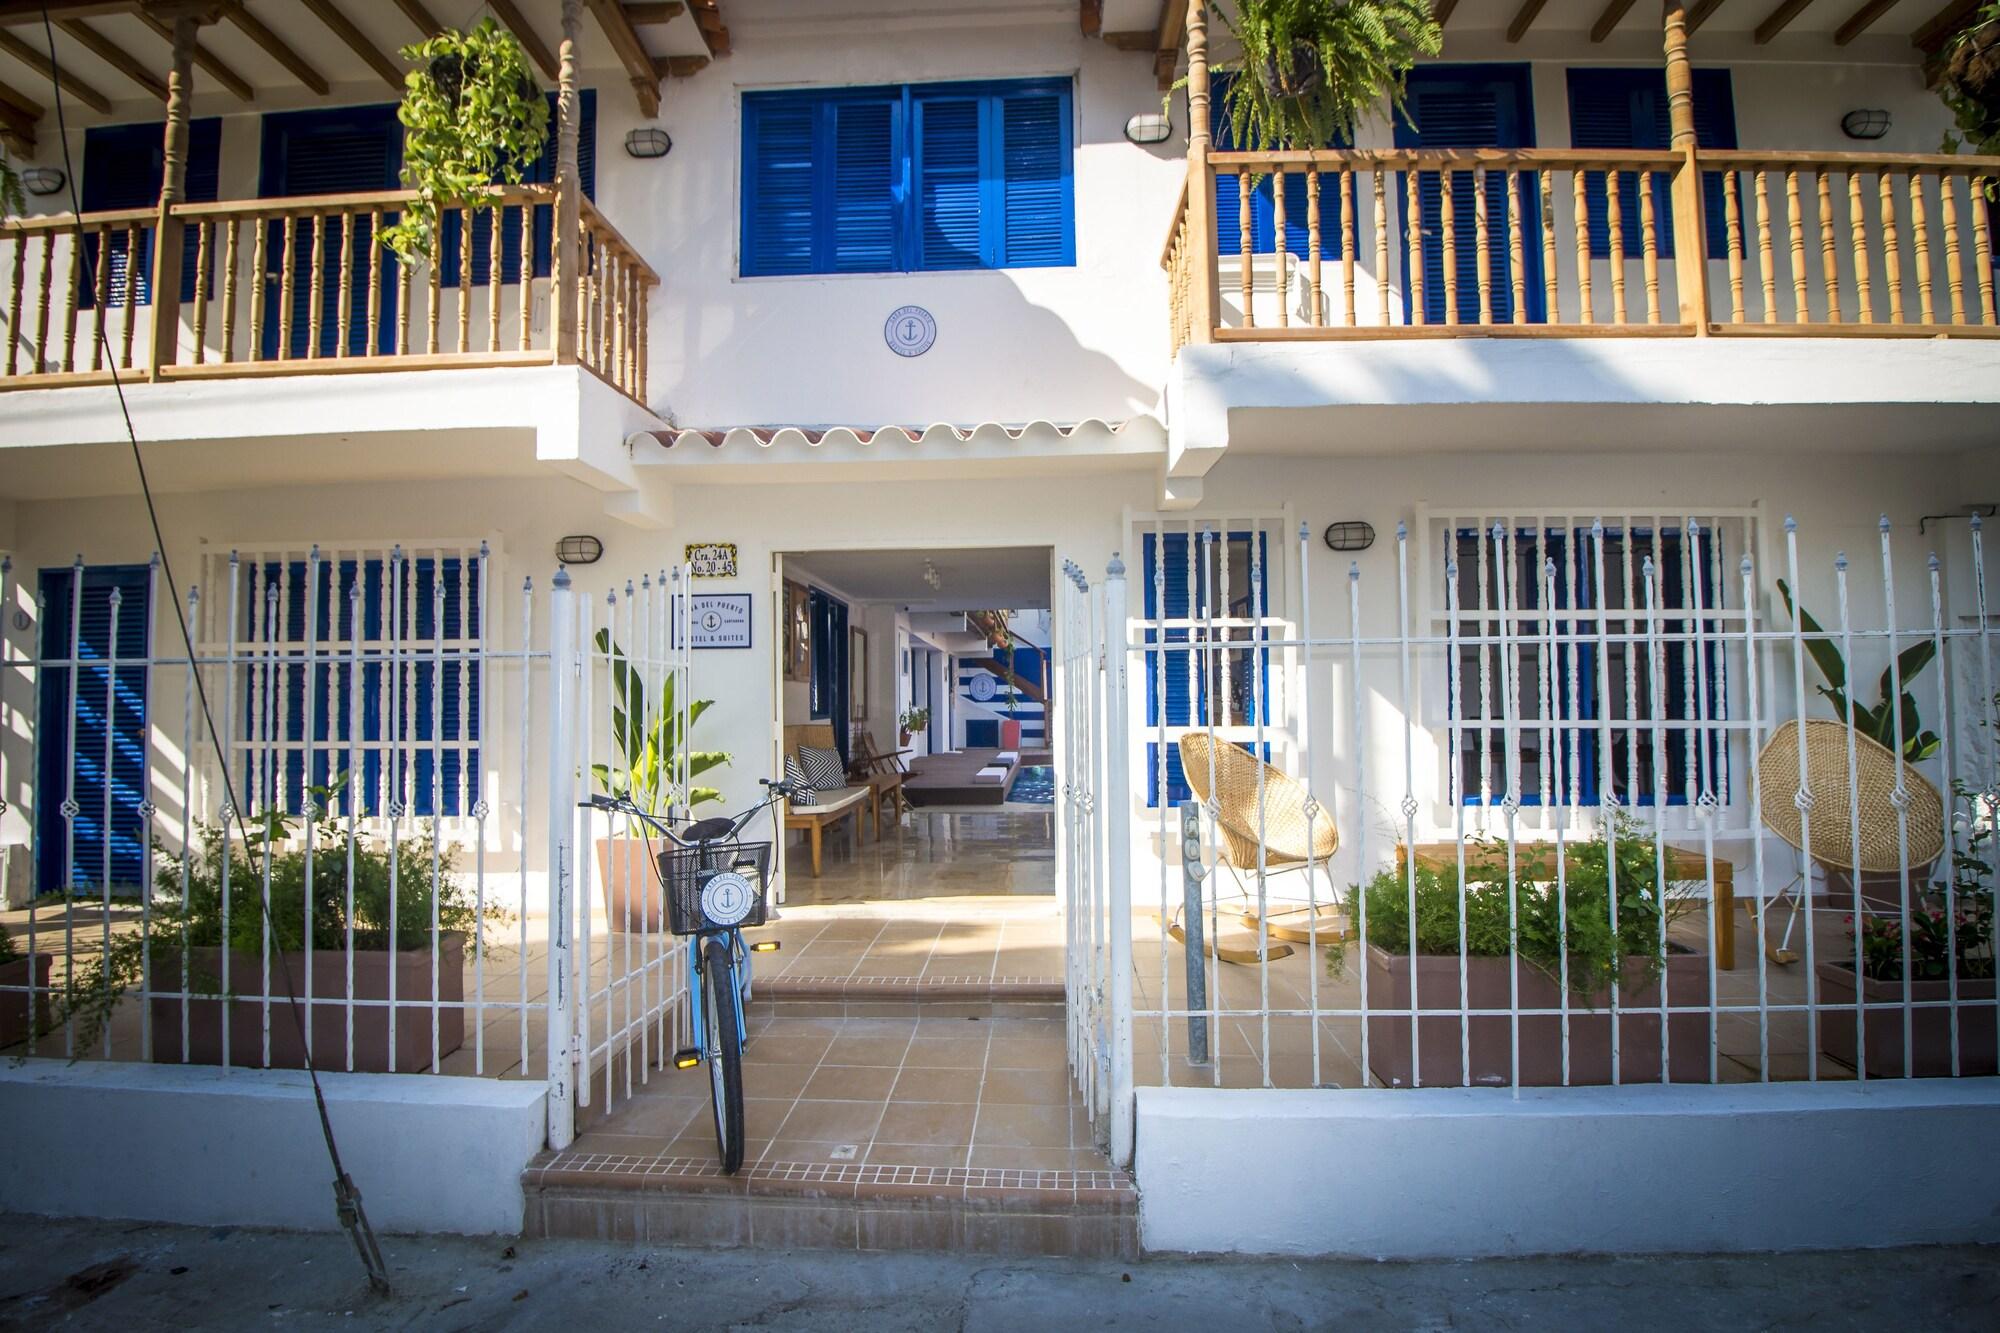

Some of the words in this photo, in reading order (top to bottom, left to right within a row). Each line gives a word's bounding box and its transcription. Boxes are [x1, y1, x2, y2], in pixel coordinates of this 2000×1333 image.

[695, 549, 710, 560] Cra.
[713, 549, 728, 560] 24A
[692, 562, 704, 572] No.
[706, 561, 716, 572] 20
[722, 561, 732, 572] 45
